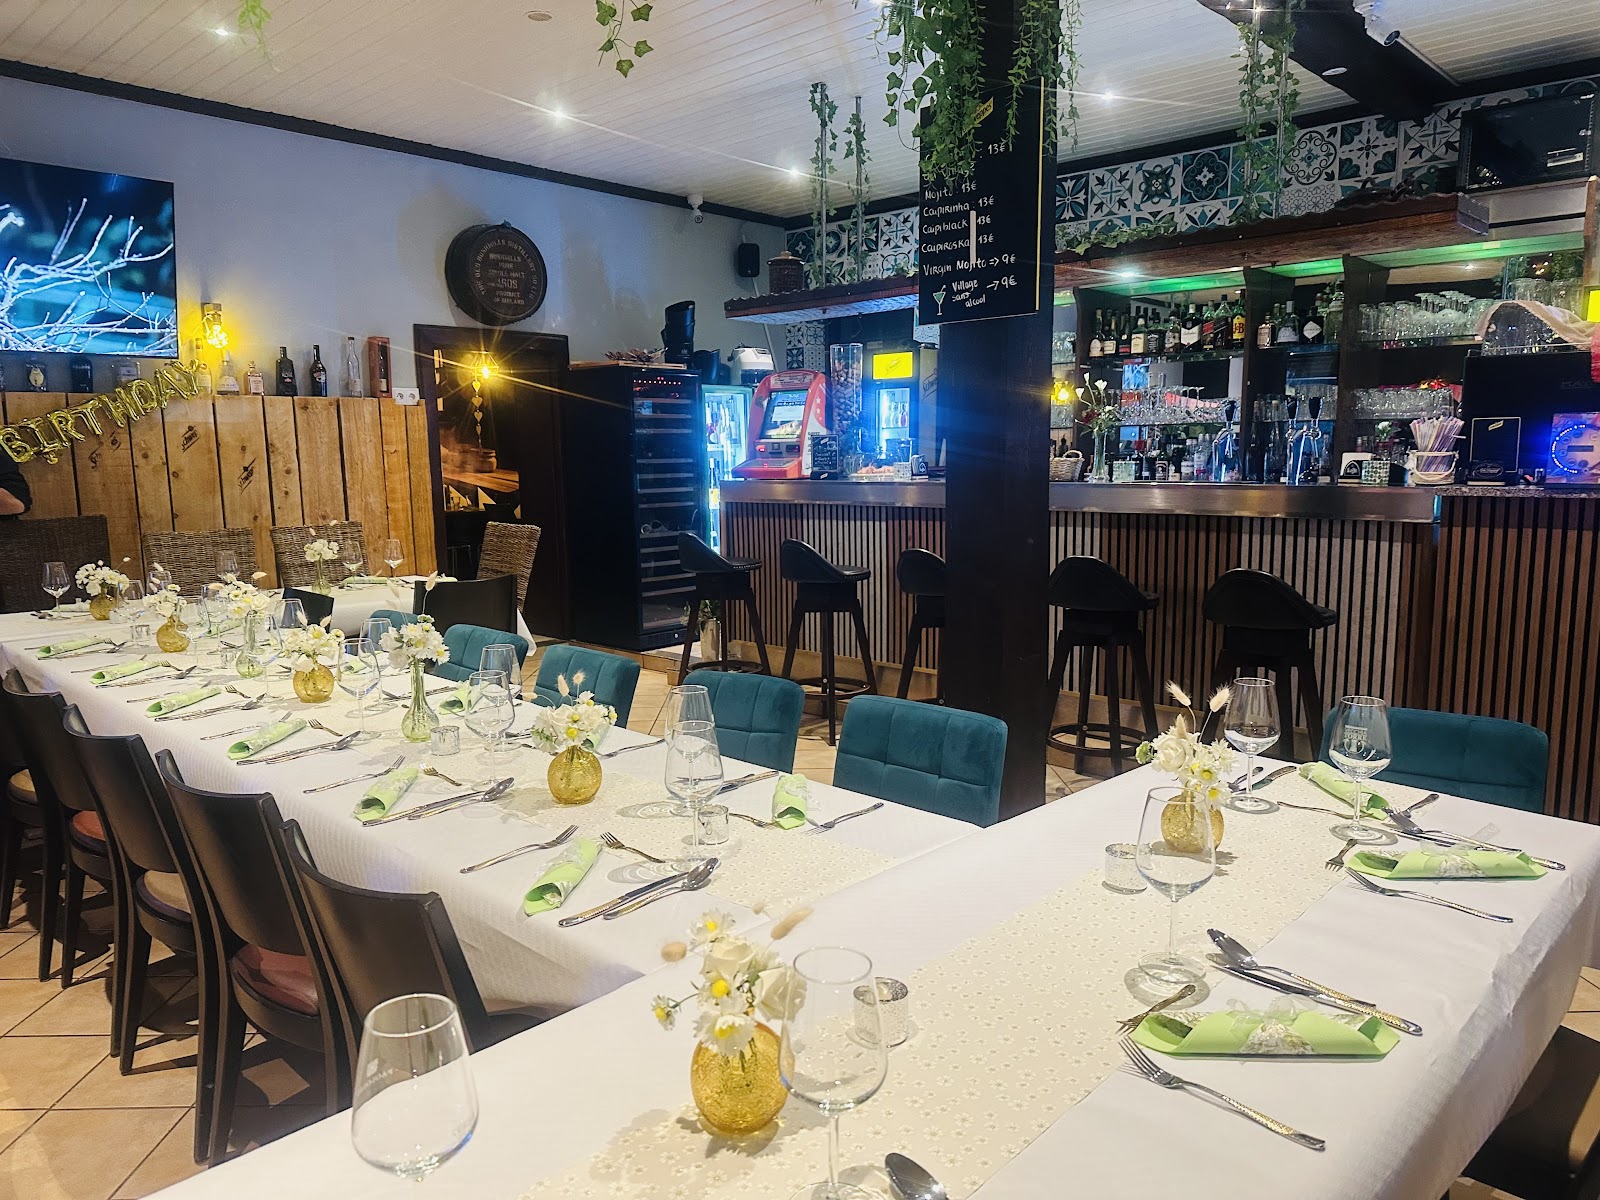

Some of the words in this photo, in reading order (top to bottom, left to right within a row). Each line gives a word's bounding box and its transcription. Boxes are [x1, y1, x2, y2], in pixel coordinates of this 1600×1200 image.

[987, 143, 1006, 155] 13€
[961, 180, 977, 193] 13€
[978, 195, 995, 207] 13€
[977, 215, 992, 225] 13€
[978, 233, 995, 244] 13€
[1001, 253, 1016, 264] 9€
[952, 280, 978, 292] Village
[1001, 275, 1017, 288] 9€
[965, 294, 986, 307] alcool
[0, 359, 201, 463] BIRTHDAY
